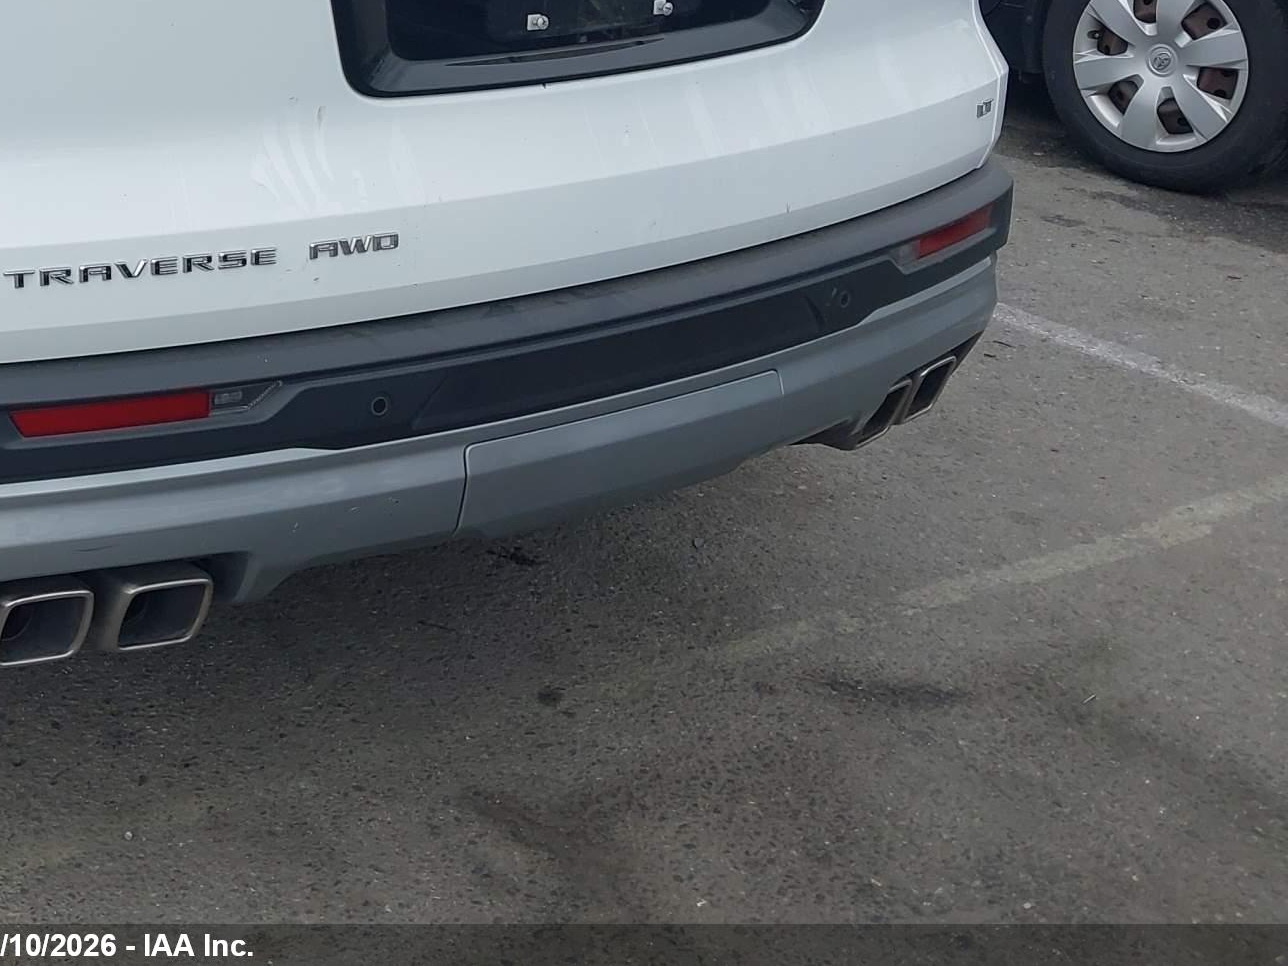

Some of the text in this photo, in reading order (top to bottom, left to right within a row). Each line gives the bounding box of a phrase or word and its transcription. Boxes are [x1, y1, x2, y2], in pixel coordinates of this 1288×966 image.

[976, 99, 993, 119] LT
[3, 231, 400, 289] TRAVERSE AWD
